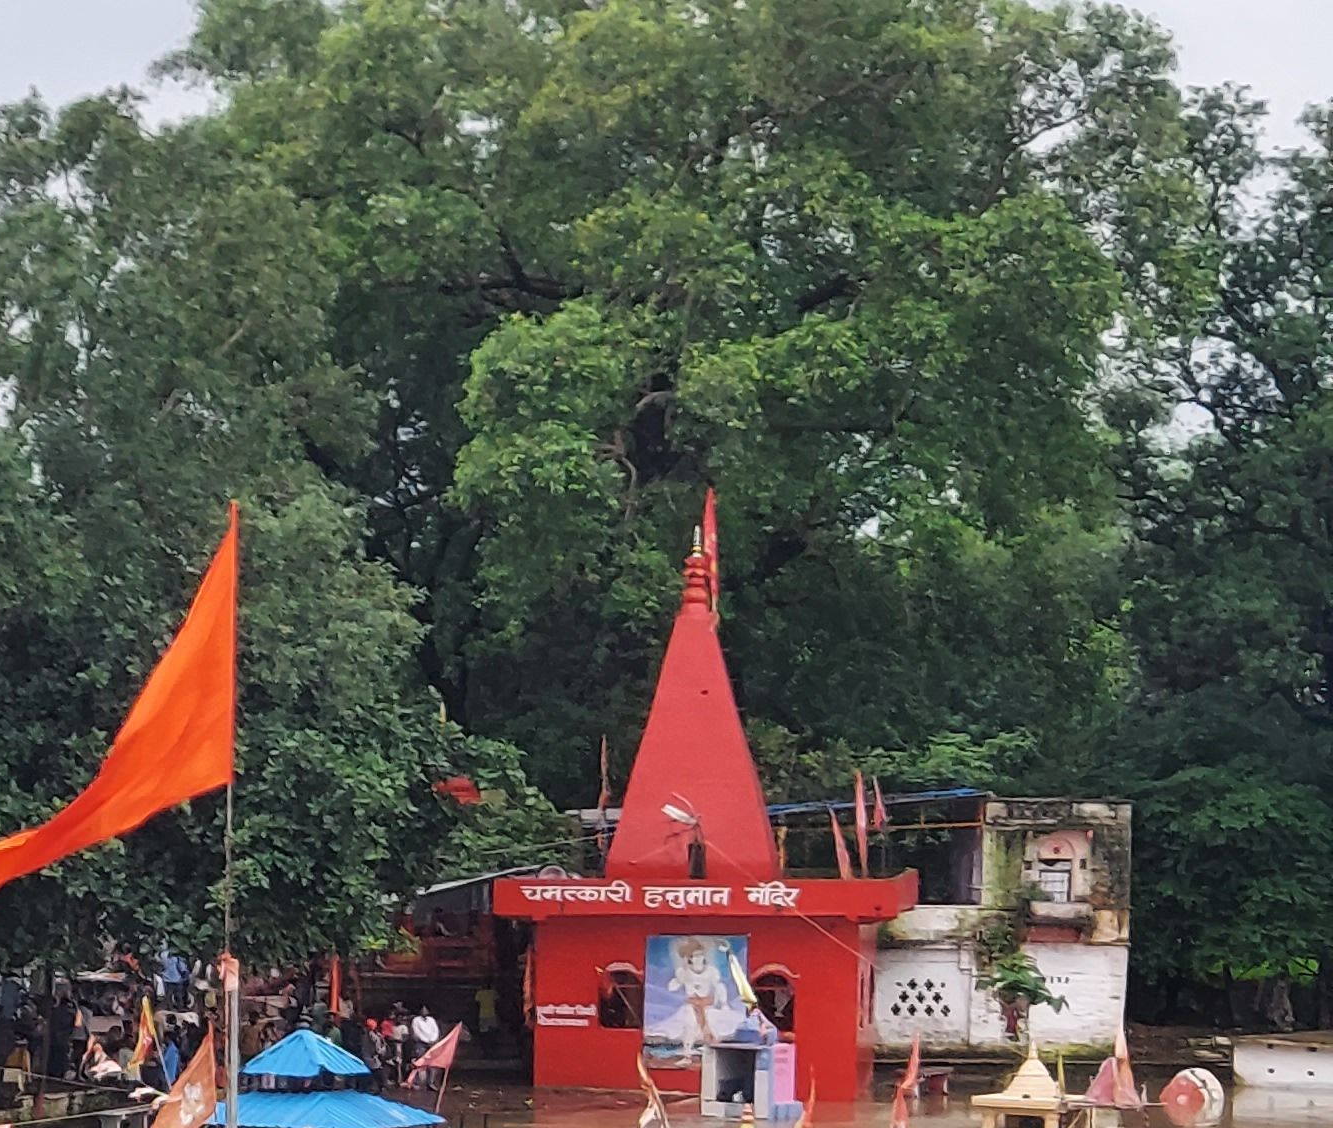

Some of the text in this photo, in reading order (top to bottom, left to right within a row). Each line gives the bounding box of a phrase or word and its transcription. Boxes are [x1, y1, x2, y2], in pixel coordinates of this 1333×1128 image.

[519, 880, 801, 909] चमत्कारी हनुमान मंदिर
